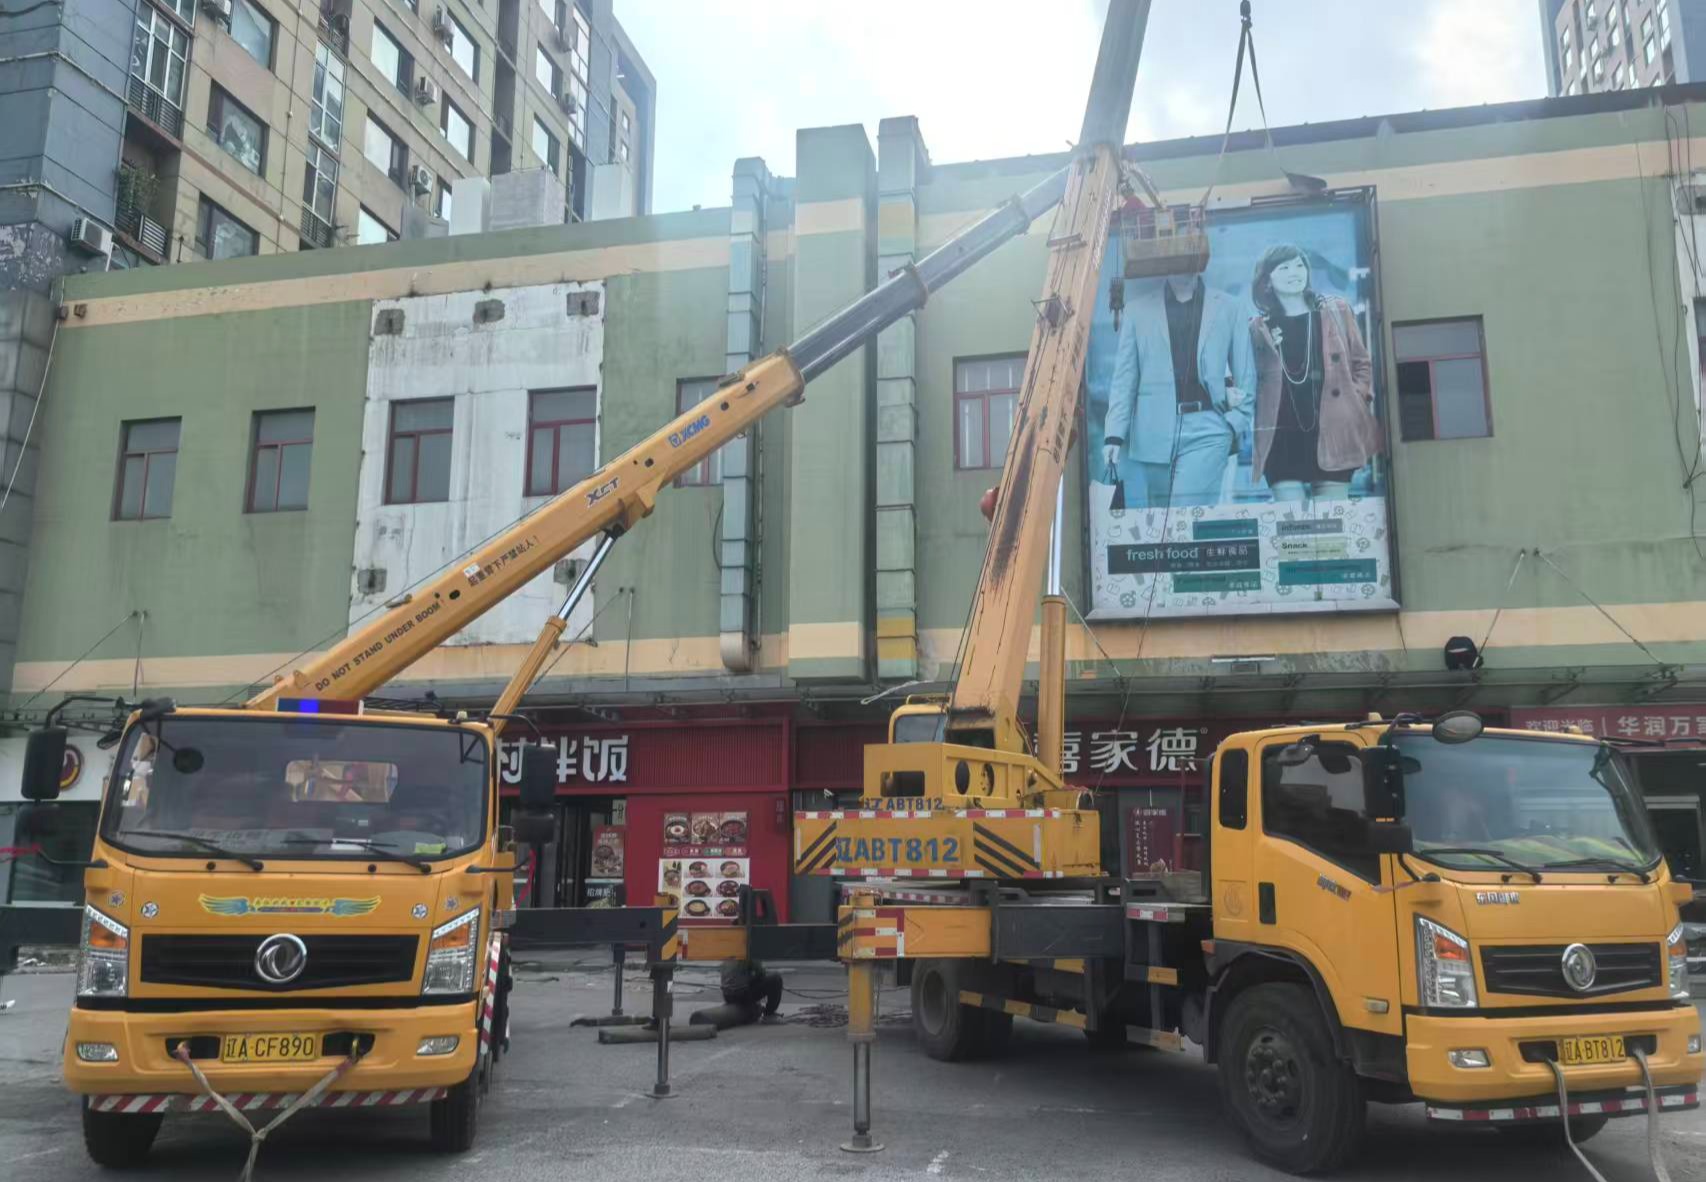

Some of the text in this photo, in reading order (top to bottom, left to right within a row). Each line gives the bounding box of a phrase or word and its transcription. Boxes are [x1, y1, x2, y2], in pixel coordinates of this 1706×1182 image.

[682, 415, 711, 441] XCMG
[586, 477, 619, 506] XCT
[1127, 549, 1164, 561] fresh
[1167, 547, 1199, 560] food
[315, 677, 330, 691] DO
[331, 663, 352, 681] NOT
[352, 641, 384, 665] STAND
[384, 619, 416, 644] UNDER
[836, 837, 959, 863] 辽ABT812
